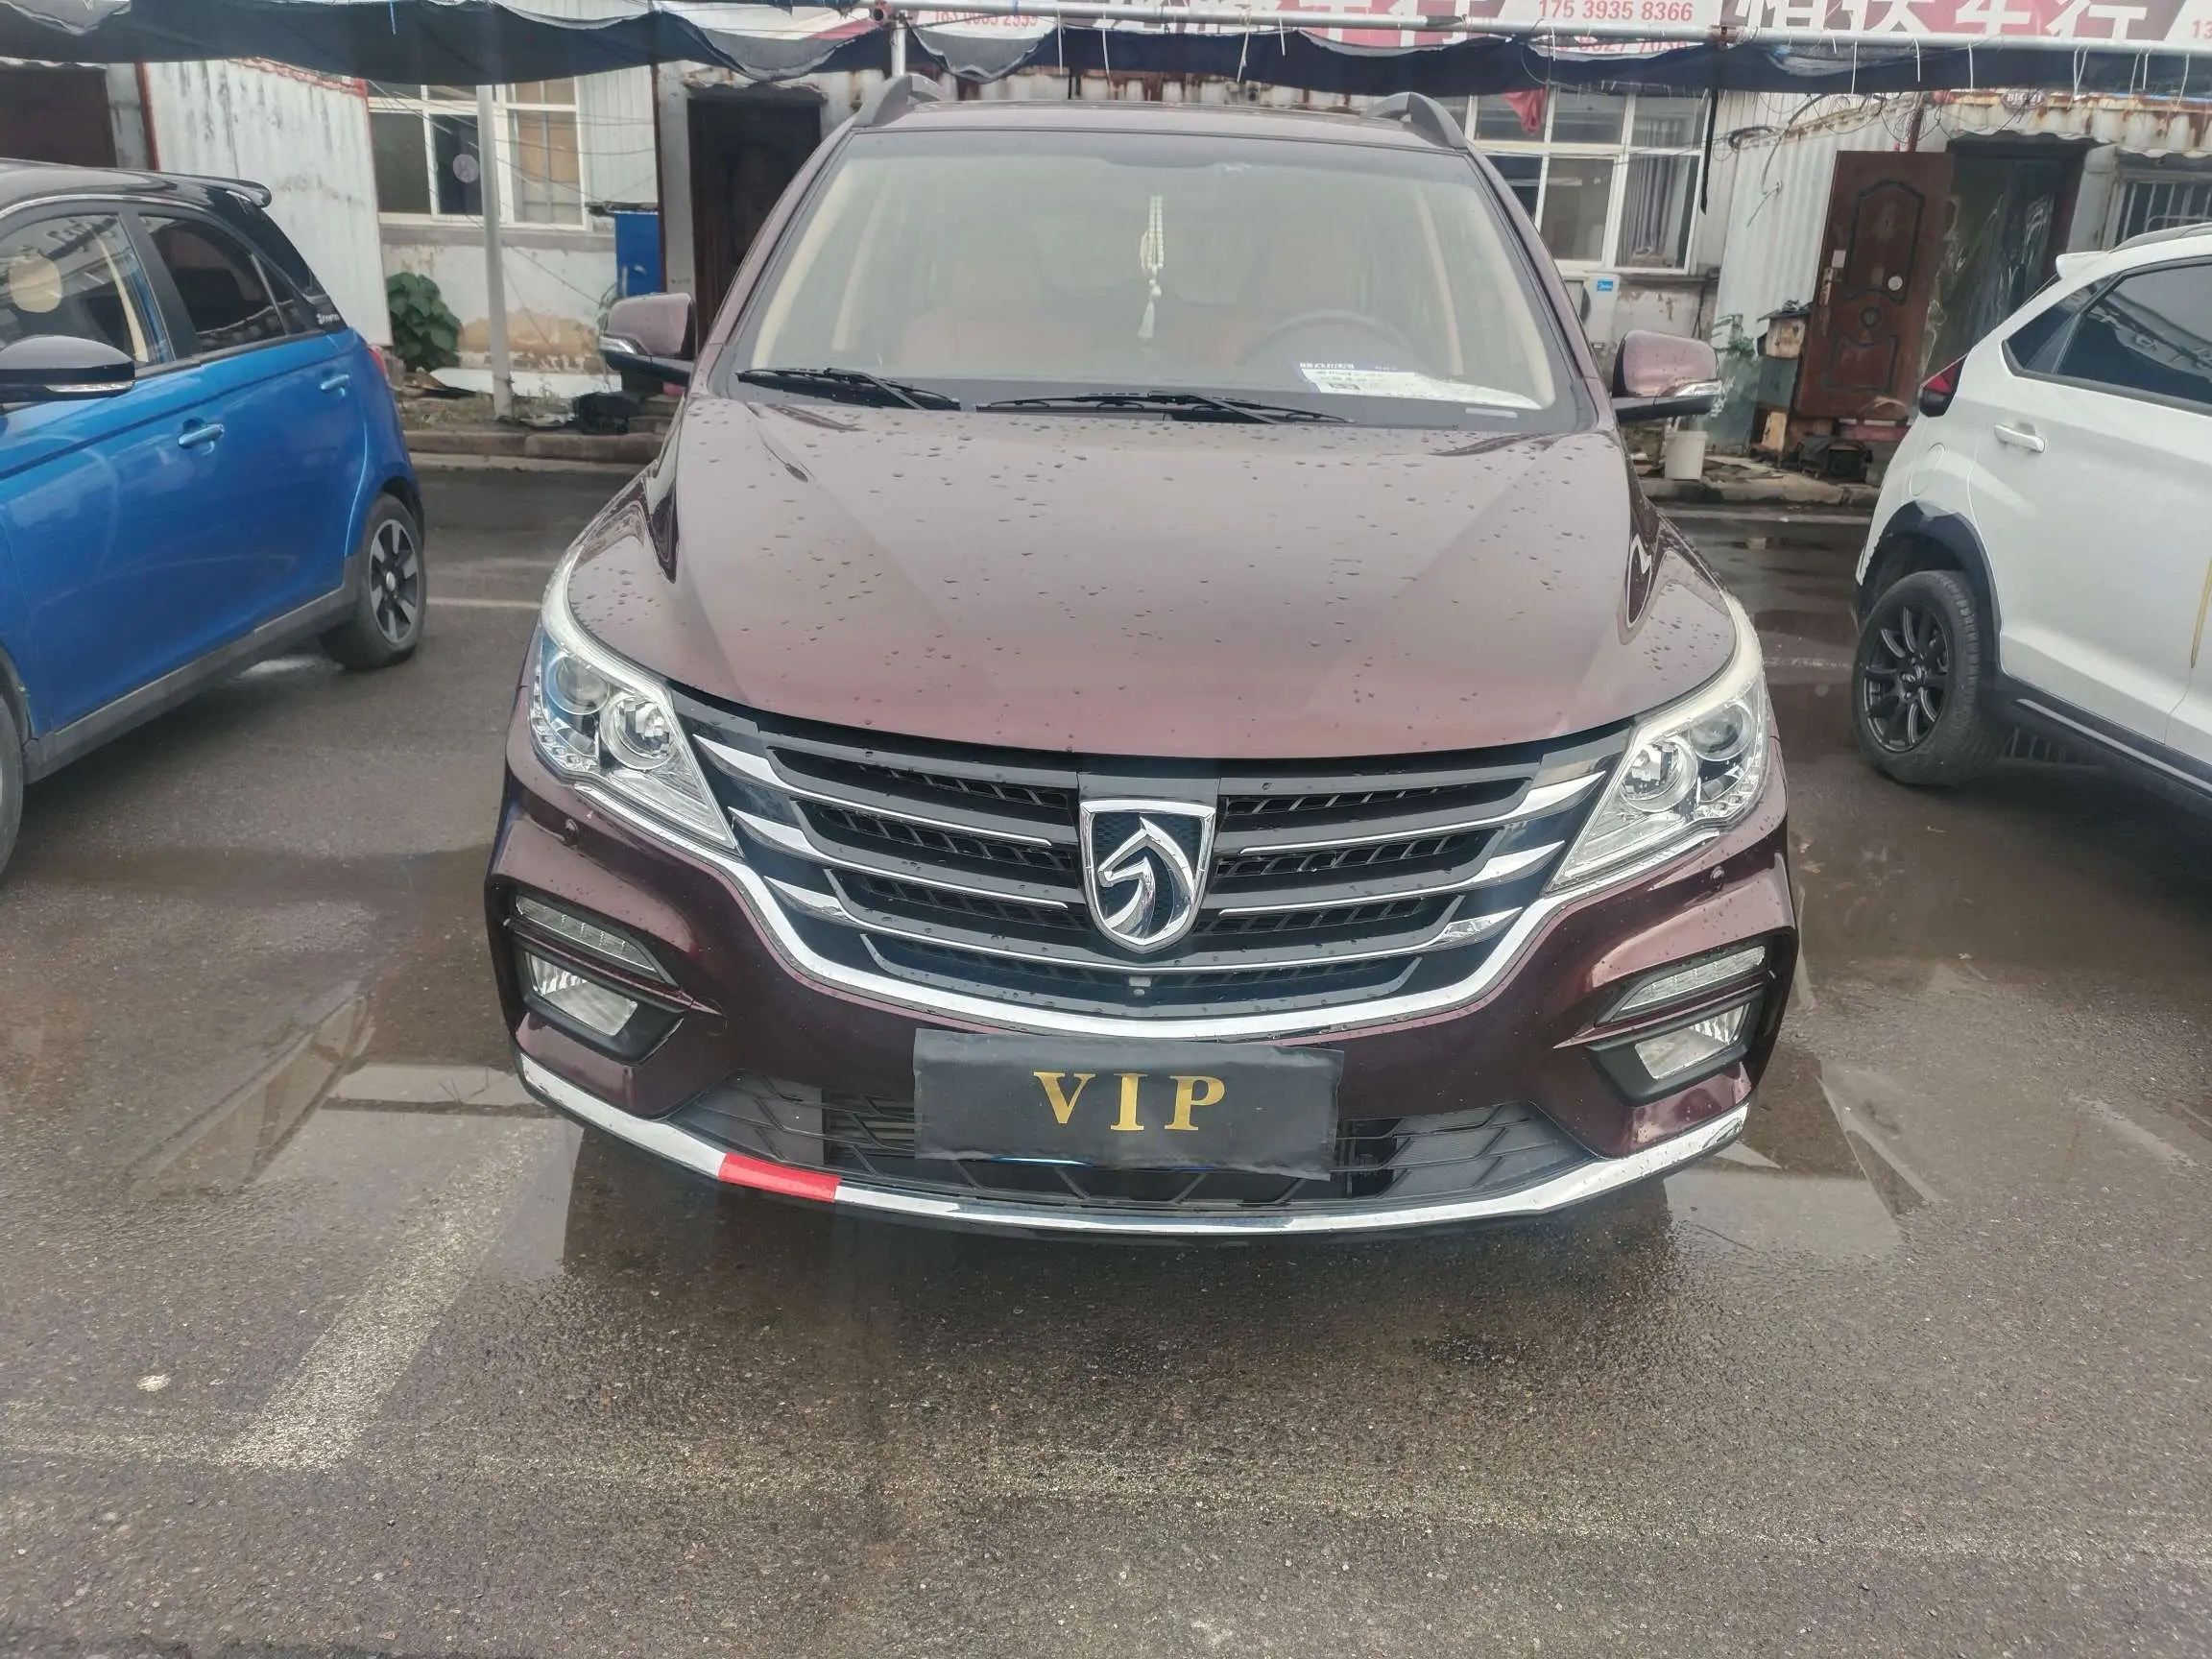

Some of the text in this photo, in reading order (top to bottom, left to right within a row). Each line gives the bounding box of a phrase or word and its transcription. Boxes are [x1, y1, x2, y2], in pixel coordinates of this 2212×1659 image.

[1539, 0, 1693, 21] 175 3935 8366
[1033, 1071, 1225, 1131] VIP
